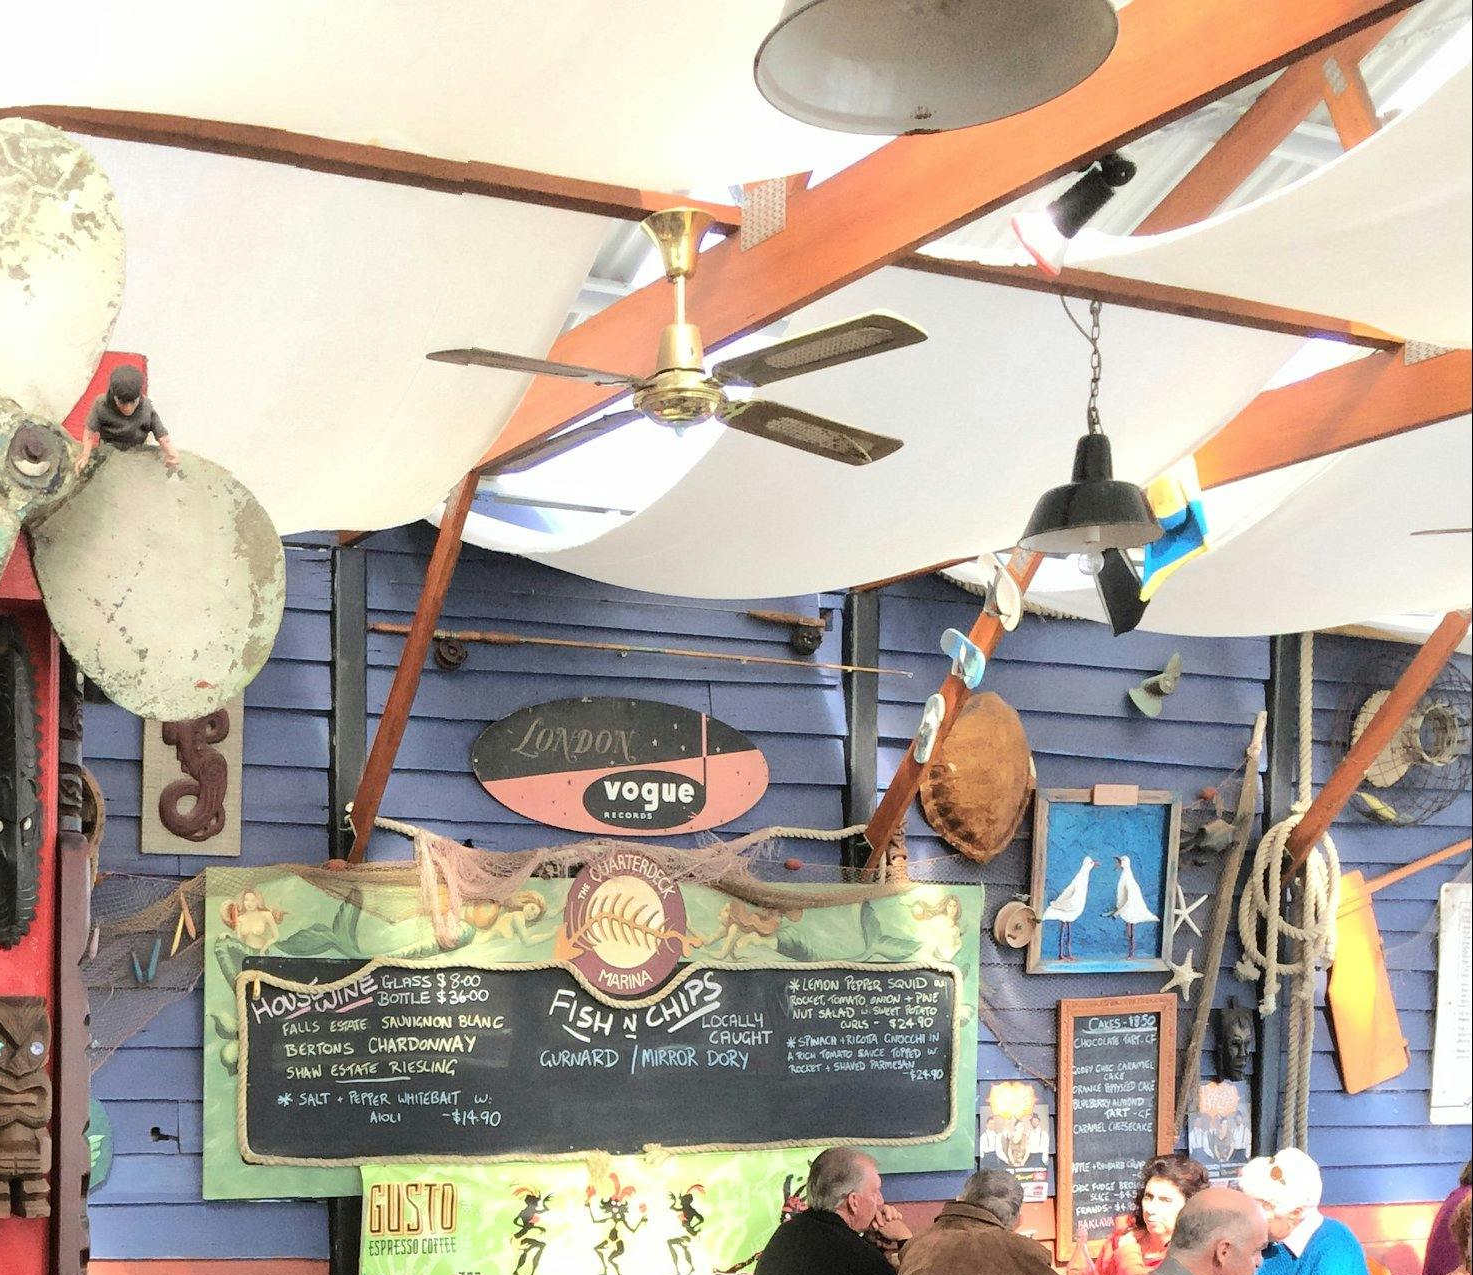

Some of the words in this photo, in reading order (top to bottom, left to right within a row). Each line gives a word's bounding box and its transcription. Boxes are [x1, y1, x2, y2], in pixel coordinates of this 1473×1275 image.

[602, 780, 696, 811] vogue
[603, 811, 654, 821] RECORDS
[577, 882, 592, 901] THE
[588, 853, 676, 900] QUARTERDECK
[381, 974, 433, 989] GLASS
[598, 969, 654, 990] MARINA
[802, 979, 840, 991] LEMON
[844, 975, 883, 992] PEPPER
[887, 977, 928, 990] SQUID
[315, 976, 379, 1013] WINE
[376, 990, 432, 1006] BOTTLE
[827, 994, 866, 1006] TOMATO
[869, 994, 901, 1004] ONION
[548, 988, 614, 1037] FISH
[622, 1013, 638, 1034] N
[645, 970, 724, 1029] CHIPS
[701, 1011, 765, 1029] LOCALLY
[792, 1008, 814, 1020] NUT
[818, 1008, 855, 1020] SALAD
[872, 1006, 902, 1017] SWEET
[905, 1005, 938, 1016] POTATO
[282, 1020, 320, 1037] FALLS
[329, 1018, 369, 1034] ESTATE
[381, 1014, 453, 1030] SAUVIGNON
[457, 1013, 505, 1030] BLANC
[840, 1019, 870, 1030] CURLS
[708, 1029, 774, 1046] CAUGHT
[797, 1034, 837, 1048] SPINACH
[928, 1032, 941, 1043] IN
[1073, 1035, 1120, 1049] CHOCOLATE
[284, 1042, 355, 1059] BERTONS
[367, 1035, 478, 1055] CHARDONNAY
[787, 1051, 795, 1062] A
[796, 1050, 816, 1060] RICH
[819, 1049, 853, 1059] TOMATO
[857, 1047, 885, 1058] SAUCE
[890, 1047, 922, 1059] TOPPED
[539, 1047, 620, 1068] GURNARD
[706, 1048, 750, 1071] DORY
[788, 1063, 822, 1074] ROCKET
[833, 1061, 866, 1072] SHAVED
[870, 1060, 916, 1071] PARMESAN
[1117, 1060, 1155, 1072] CARAMEL
[286, 1064, 323, 1081] SHAW
[330, 1061, 378, 1077] ESTATE
[389, 1058, 459, 1077] RIESLING
[1103, 1072, 1126, 1081] CAKE
[1138, 1080, 1155, 1092] CAKE
[298, 1092, 331, 1107] SALT
[348, 1090, 392, 1107] PEPPER
[397, 1090, 462, 1107] WHITEBAIT
[369, 1110, 402, 1124] AIOLI
[1103, 1107, 1131, 1120] TART
[1073, 1122, 1107, 1134] CARAMEL
[1091, 1181, 1116, 1192] FUDGE
[368, 1181, 459, 1237] GUSTO
[368, 1237, 419, 1257] ESPRESSO
[421, 1236, 458, 1255] COFFEE
